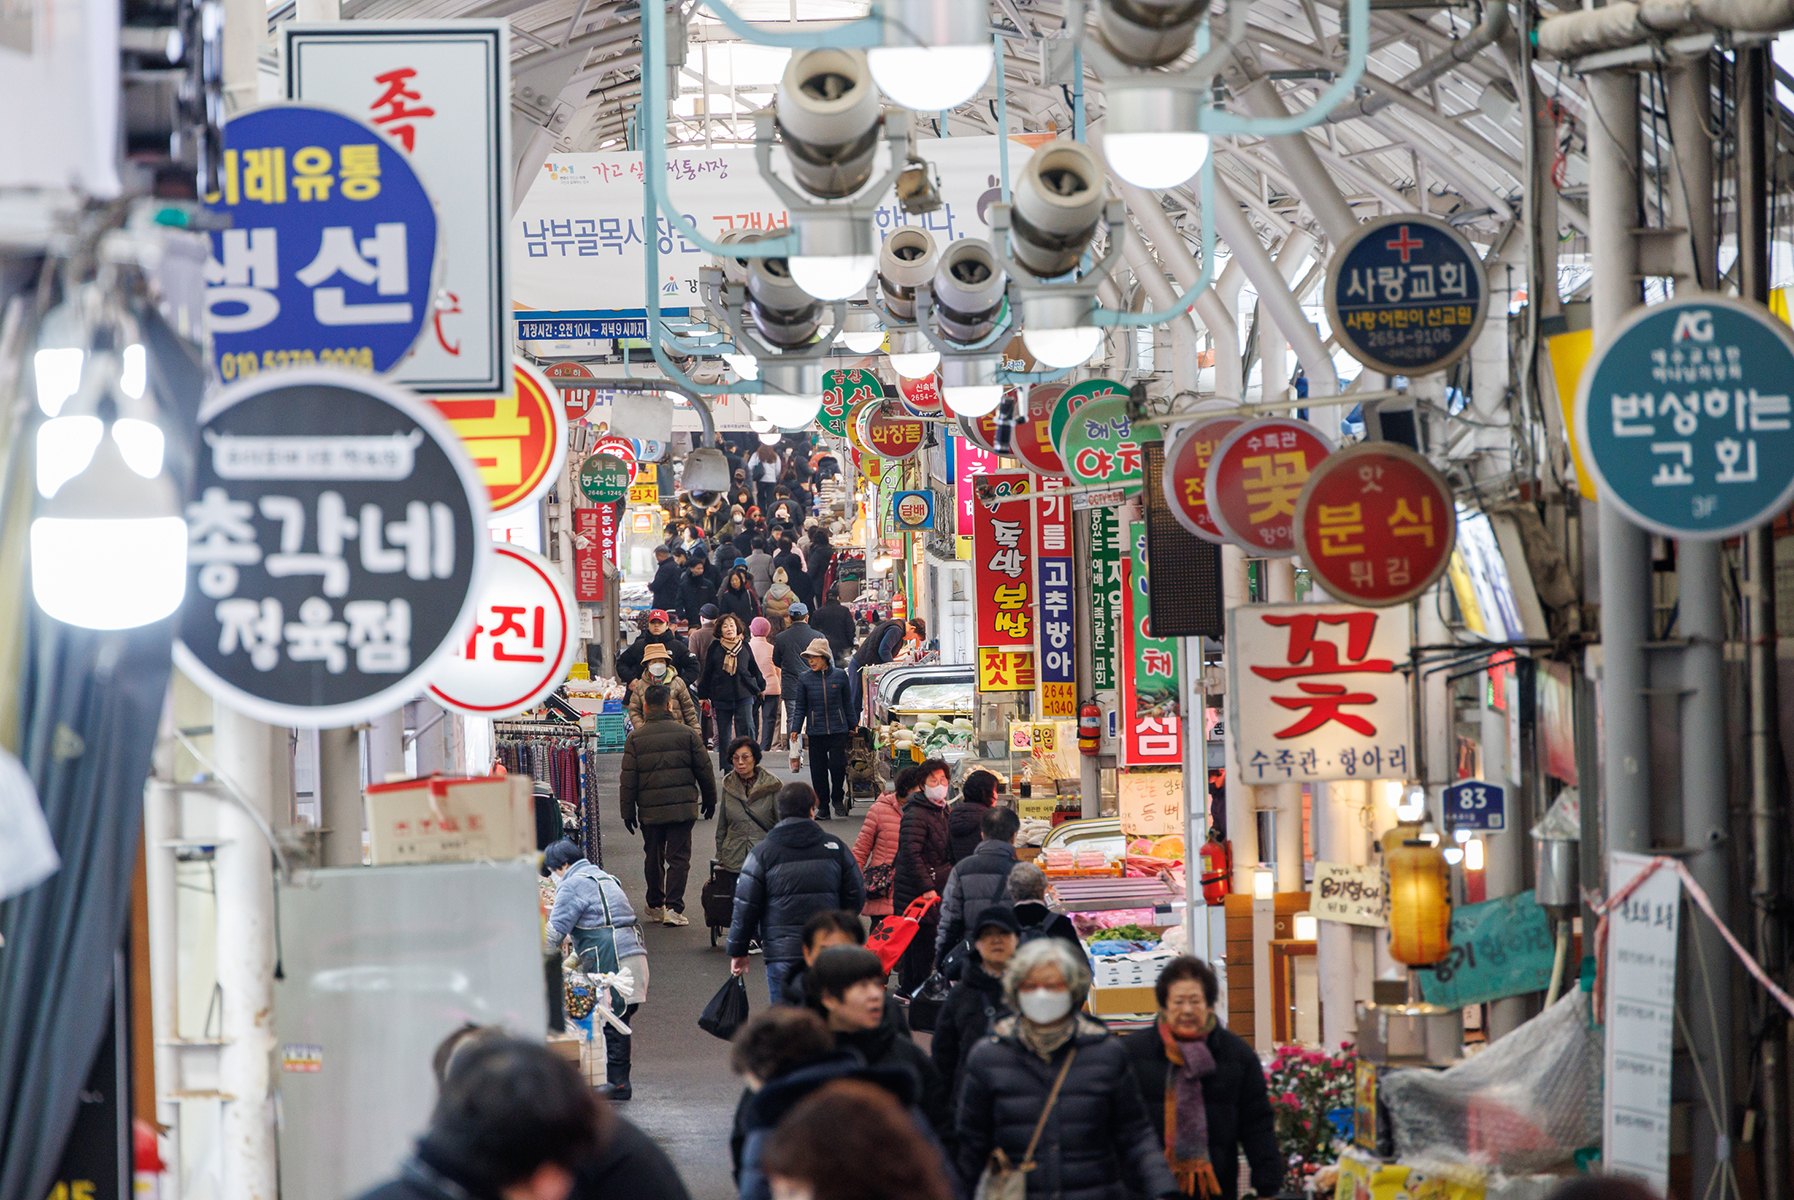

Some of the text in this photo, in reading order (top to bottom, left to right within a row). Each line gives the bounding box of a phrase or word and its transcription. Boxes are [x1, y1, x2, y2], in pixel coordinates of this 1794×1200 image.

[1346, 262, 1468, 304] 사랑교회
[831, 369, 862, 385] 금산
[1084, 414, 1132, 440] 해남
[1611, 387, 1792, 438] 번성하는
[872, 423, 921, 445] 화장품
[581, 474, 627, 488] 농수산물
[629, 489, 657, 501] 김치
[901, 504, 925, 517] 담배
[187, 486, 457, 599] 총각네
[1043, 561, 1072, 677] 고추방아
[215, 596, 412, 675] 정육점
[985, 653, 1035, 687] 젓갈
[1095, 656, 1108, 687] 교회
[1250, 611, 1396, 740] 꽃
[1460, 787, 1488, 810] 83
